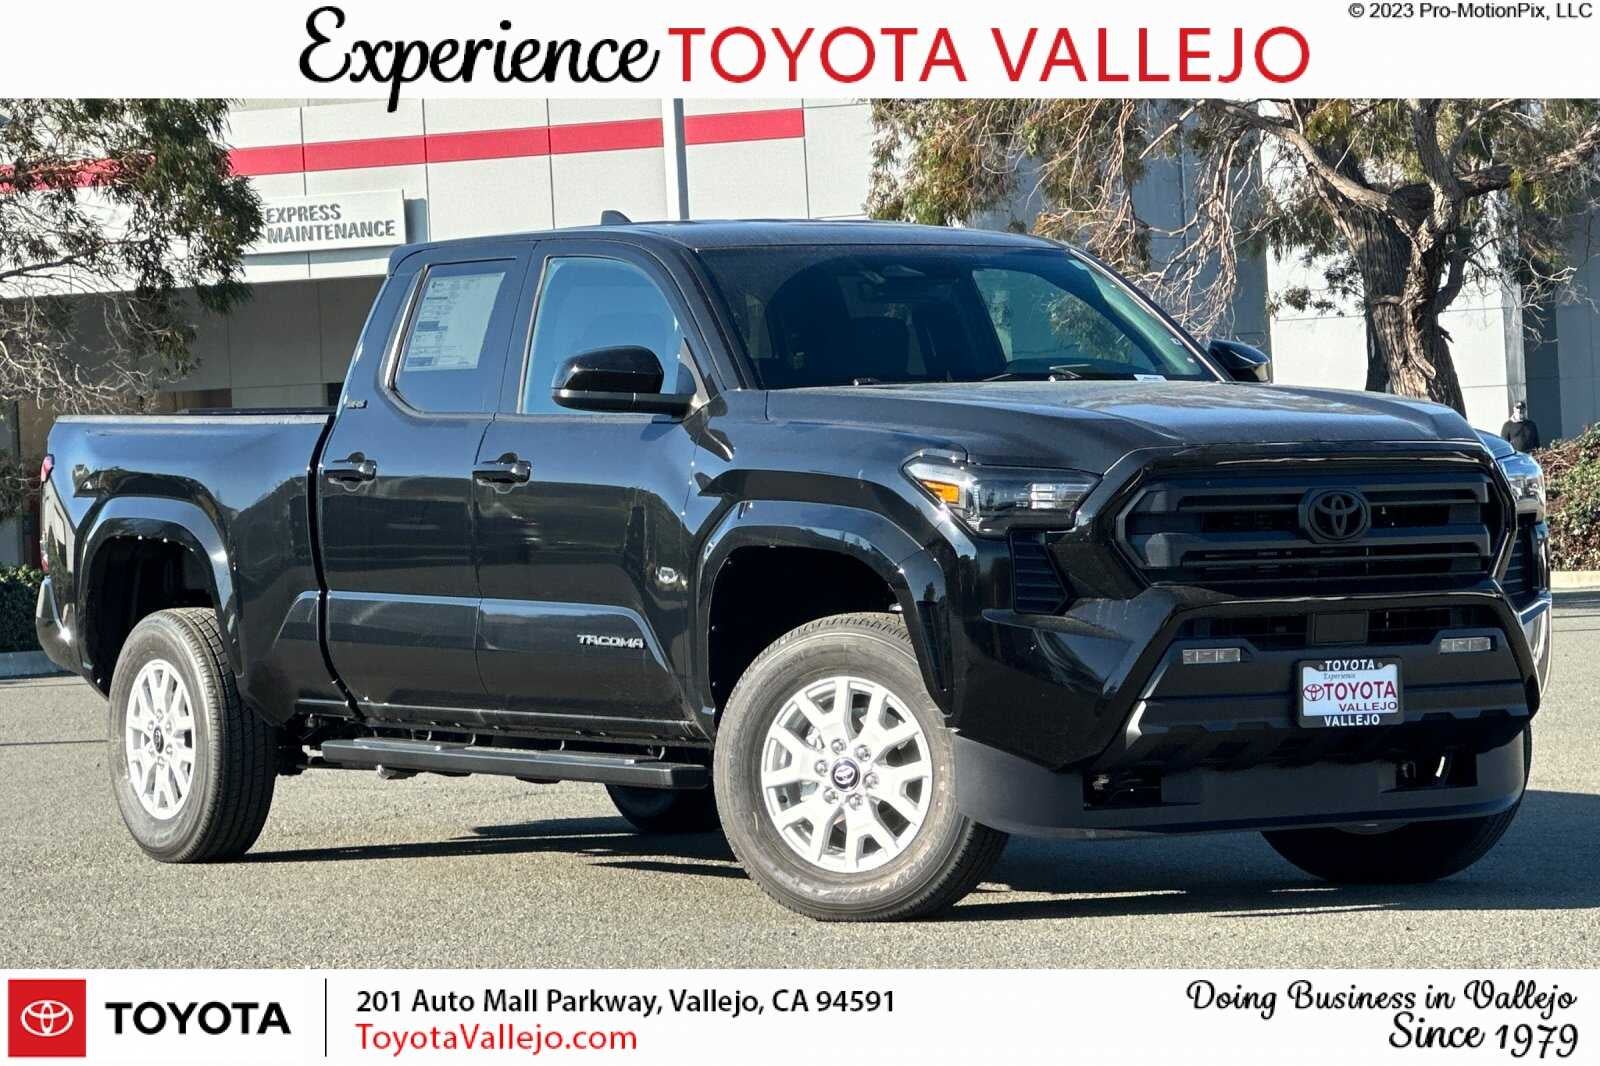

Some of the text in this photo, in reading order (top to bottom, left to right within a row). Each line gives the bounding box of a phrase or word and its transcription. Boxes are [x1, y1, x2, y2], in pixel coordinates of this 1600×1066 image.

[266, 203, 342, 224] EXPRESS
[267, 219, 395, 243] MAINTENANCE
[577, 634, 643, 648] TACOMA
[1325, 659, 1375, 670] TOYOTA
[1323, 681, 1397, 700] TOYOTA
[1339, 702, 1397, 711] VALLEJO
[1324, 714, 1380, 727] VALLEJO
